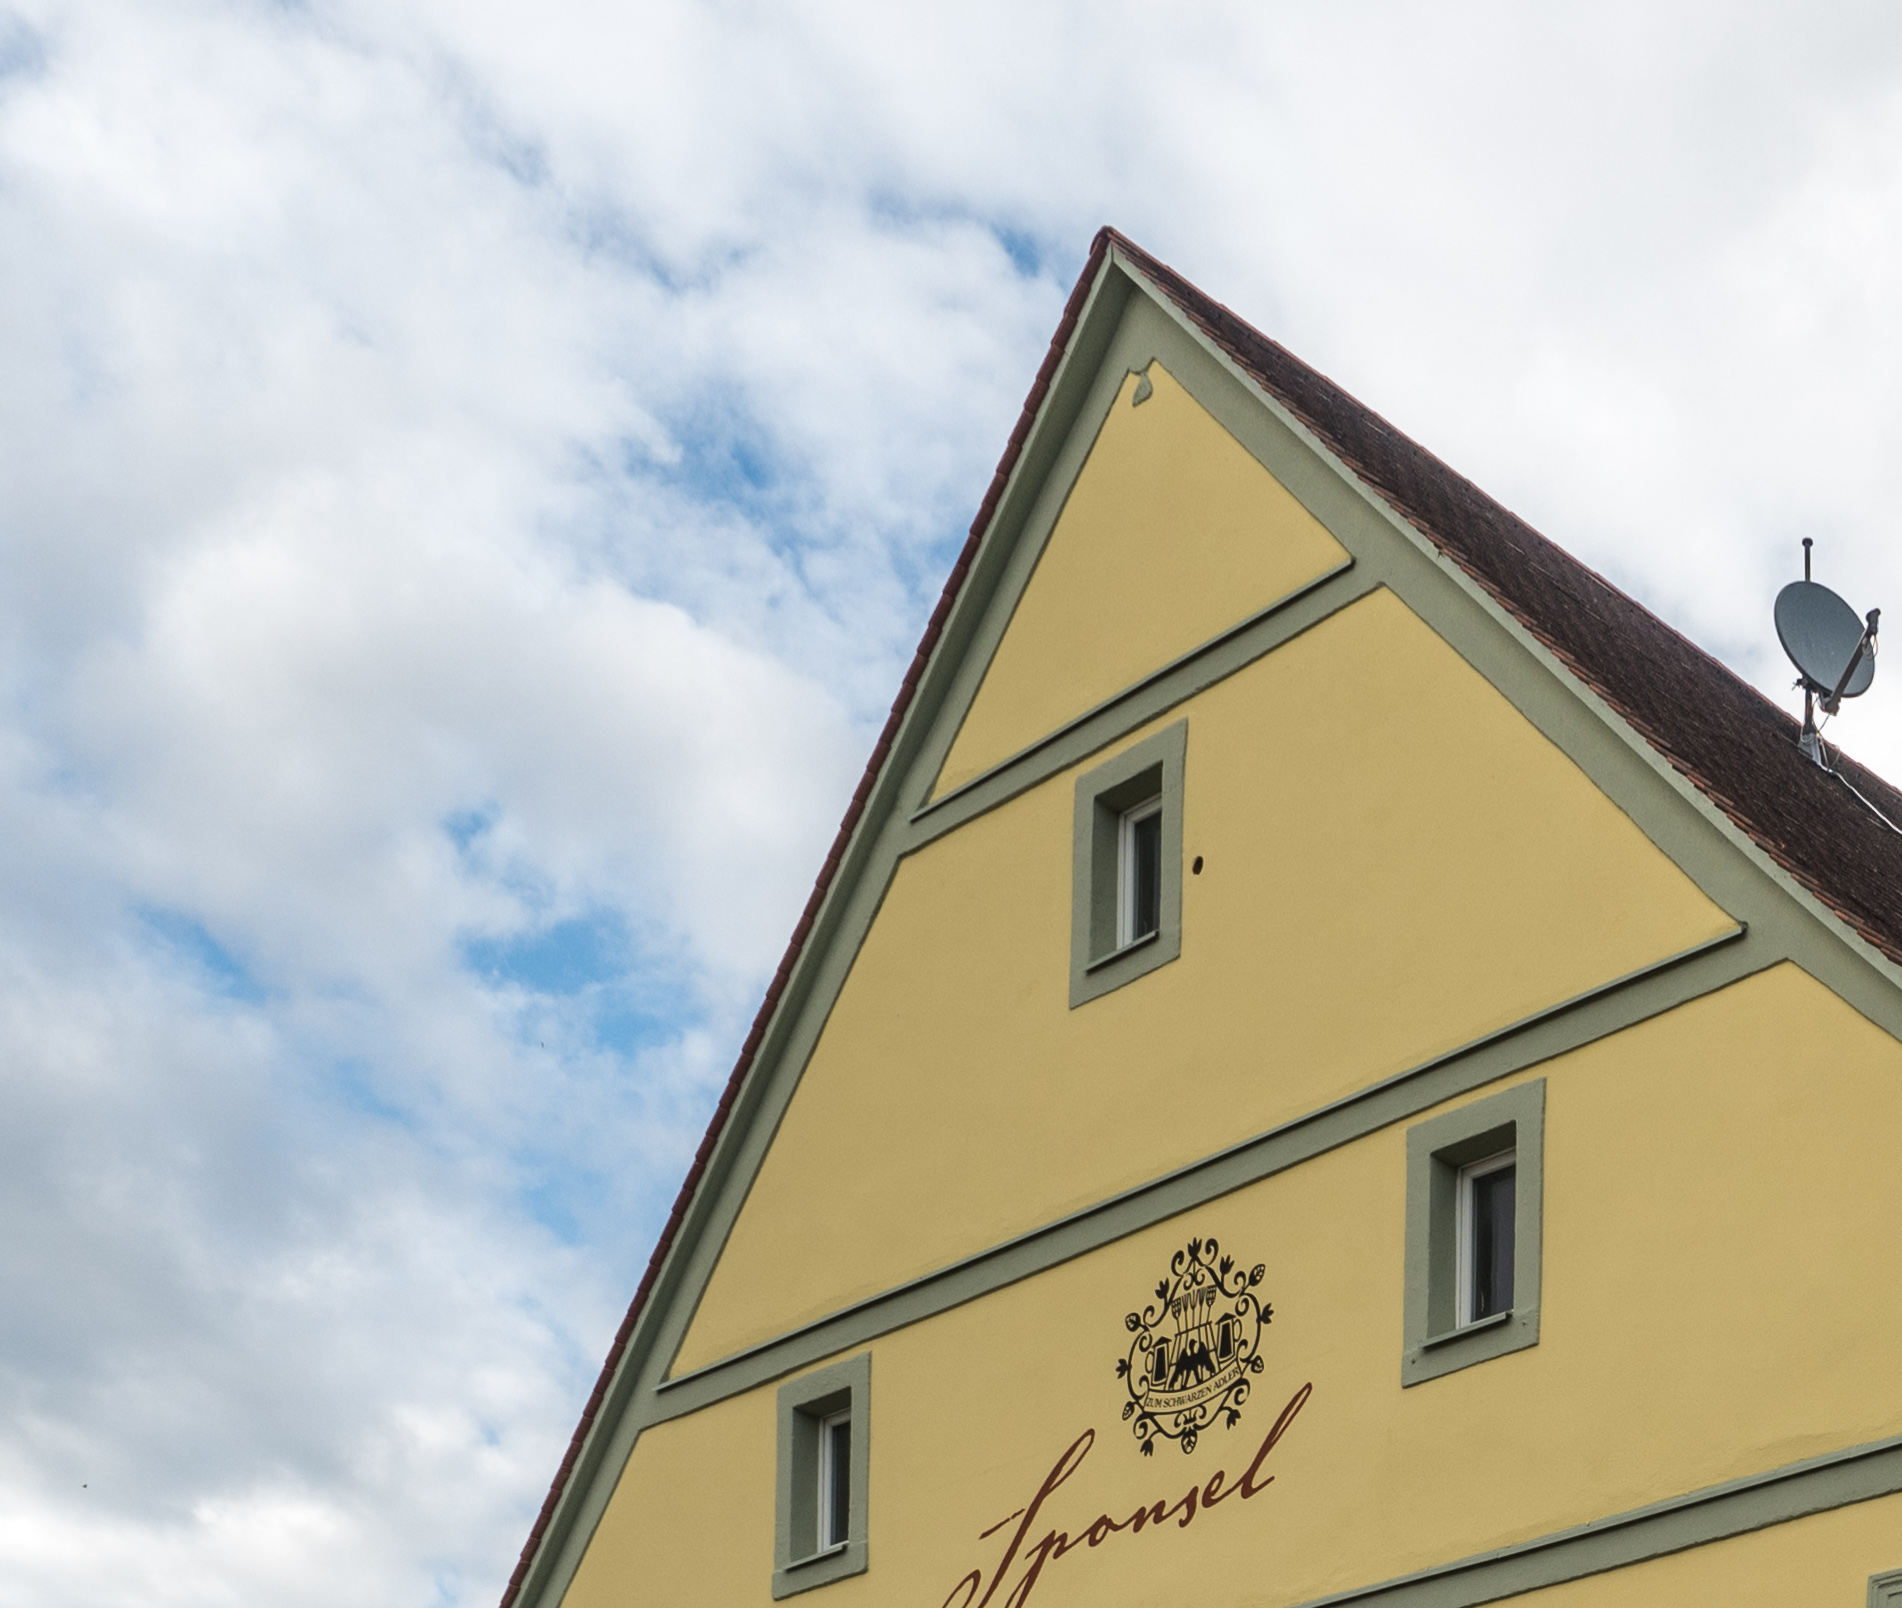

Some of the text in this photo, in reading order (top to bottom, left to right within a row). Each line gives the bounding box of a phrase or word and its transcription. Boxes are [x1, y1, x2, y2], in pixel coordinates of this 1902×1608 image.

[1145, 1366, 1240, 1408] ZUM SCHWARZEN ADLER
